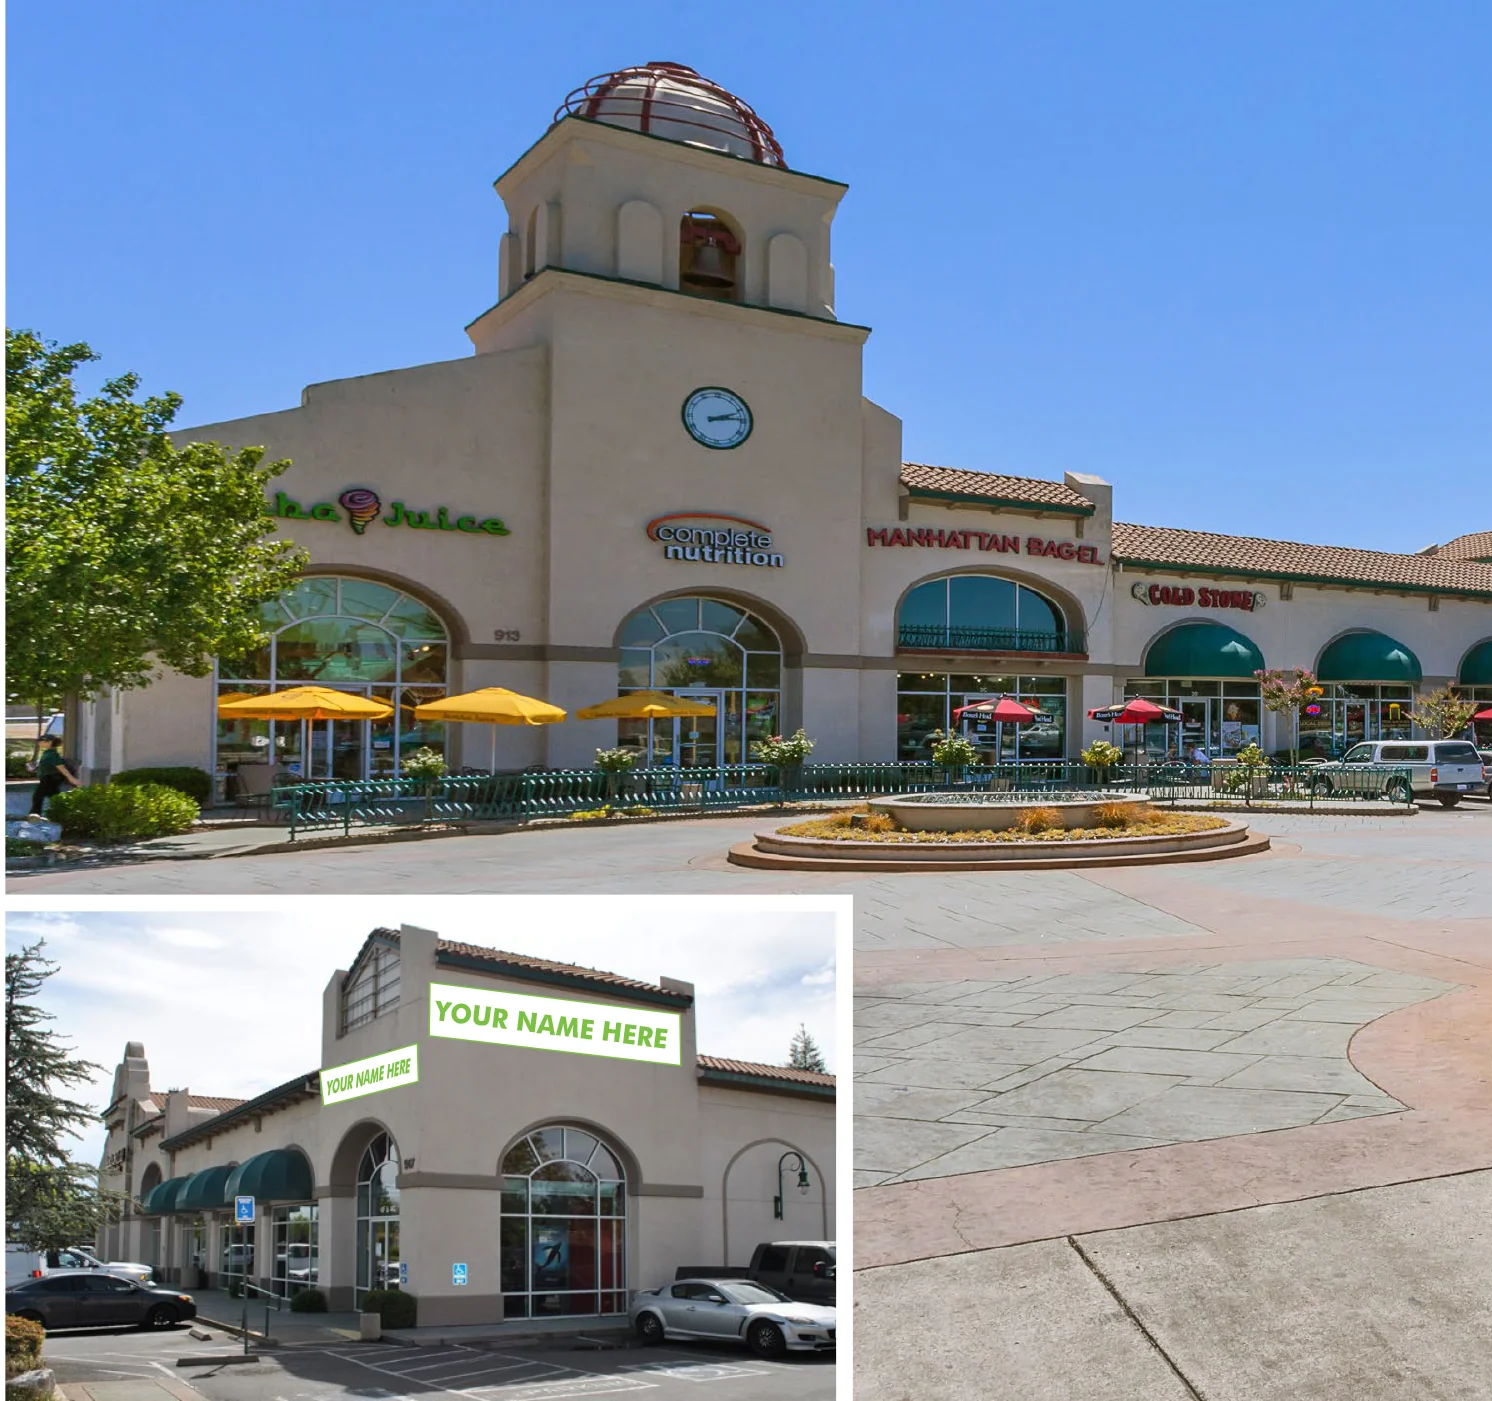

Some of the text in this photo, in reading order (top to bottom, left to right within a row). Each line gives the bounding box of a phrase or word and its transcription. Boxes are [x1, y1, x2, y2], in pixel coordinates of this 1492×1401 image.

[384, 502, 512, 536] Juice
[657, 526, 773, 549] complete
[866, 527, 1105, 566] MANHATTAN BAGEL
[665, 545, 784, 567] nutrition
[1148, 583, 1253, 610] COLD STONE
[494, 629, 520, 642] 913
